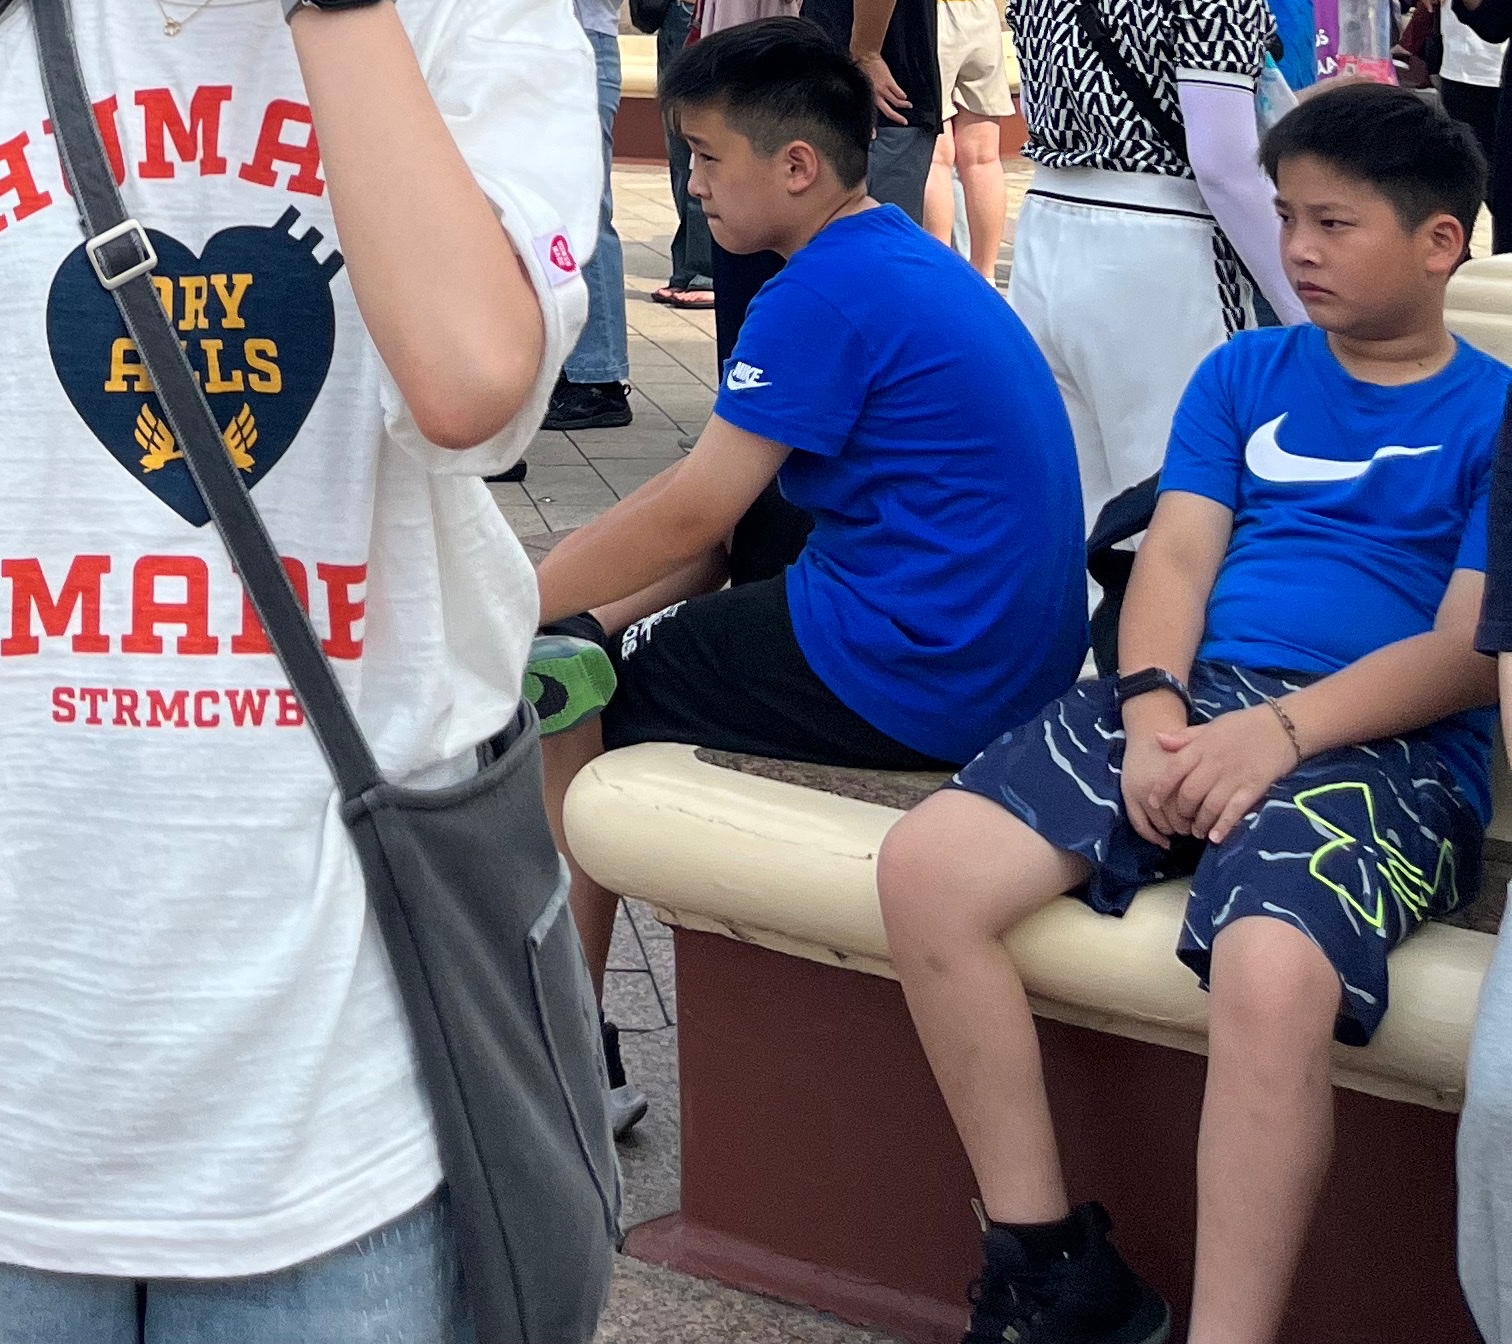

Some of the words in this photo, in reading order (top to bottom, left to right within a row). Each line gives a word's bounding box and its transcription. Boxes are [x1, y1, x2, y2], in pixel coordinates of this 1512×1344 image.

[103, 336, 284, 394] ALS
[732, 360, 764, 384] NIKE
[51, 685, 308, 729] STRMCWB
